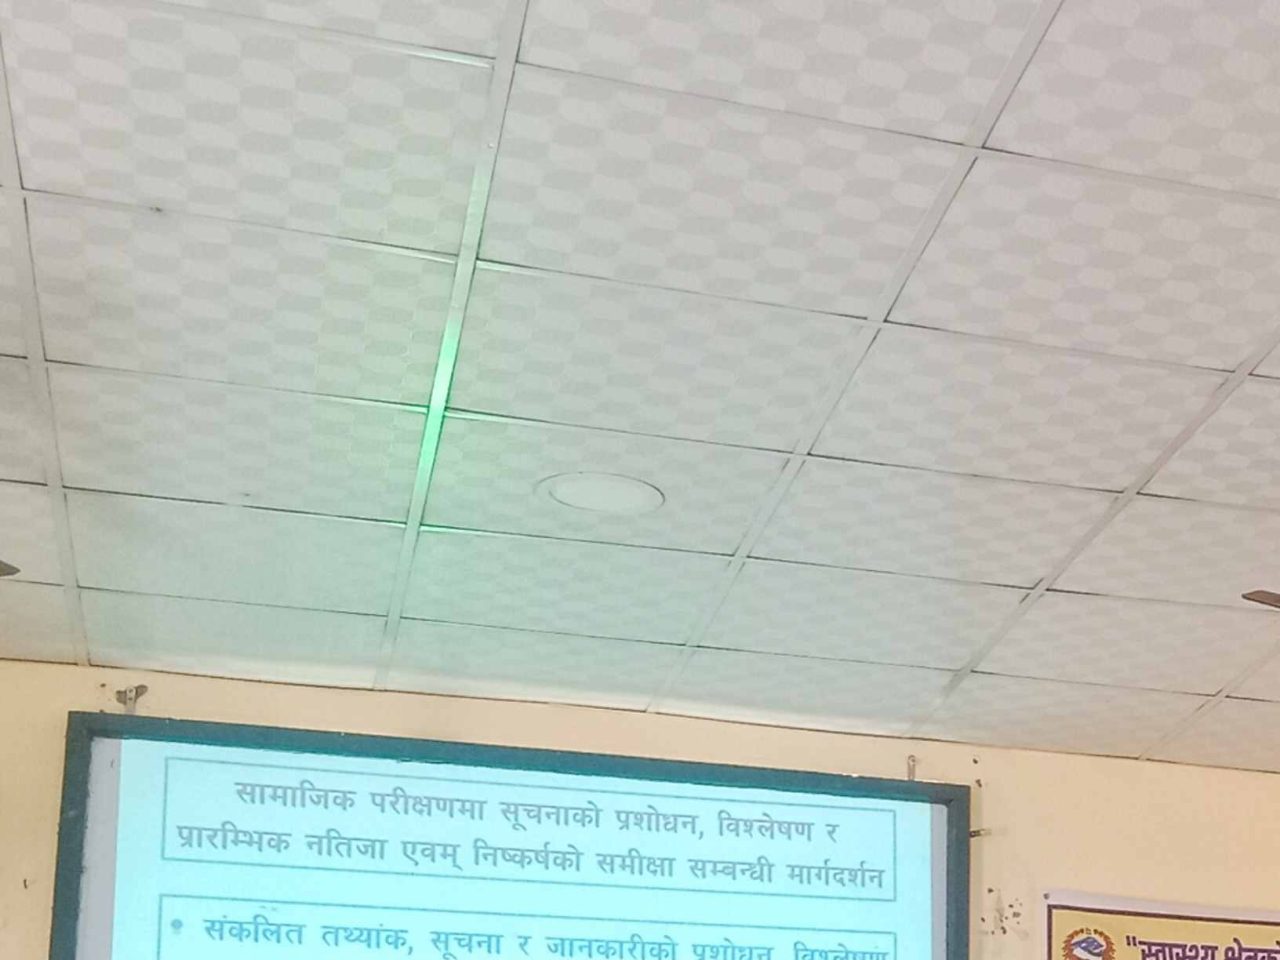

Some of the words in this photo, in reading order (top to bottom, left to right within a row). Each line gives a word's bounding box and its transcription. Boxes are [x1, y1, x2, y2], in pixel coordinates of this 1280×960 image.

[235, 779, 356, 812] सामाजिक
[370, 787, 486, 820] परीक्षणमा
[500, 800, 601, 831] सूचनाको
[615, 804, 705, 840] प्रशोधन,
[718, 809, 814, 842] विश्लेषण
[826, 822, 839, 843] र
[177, 821, 292, 853] प्रारम्भिक
[306, 832, 387, 861] नतिजा
[401, 841, 462, 872] एवम्
[474, 839, 583, 873] निष्कर्षको
[596, 850, 674, 878] समीक्षा
[787, 858, 885, 890] मार्गदर्शन
[203, 914, 306, 945] संकलित
[321, 923, 413, 955] तथ्यांक,
[430, 930, 503, 960] सूचना
[518, 935, 532, 957] र
